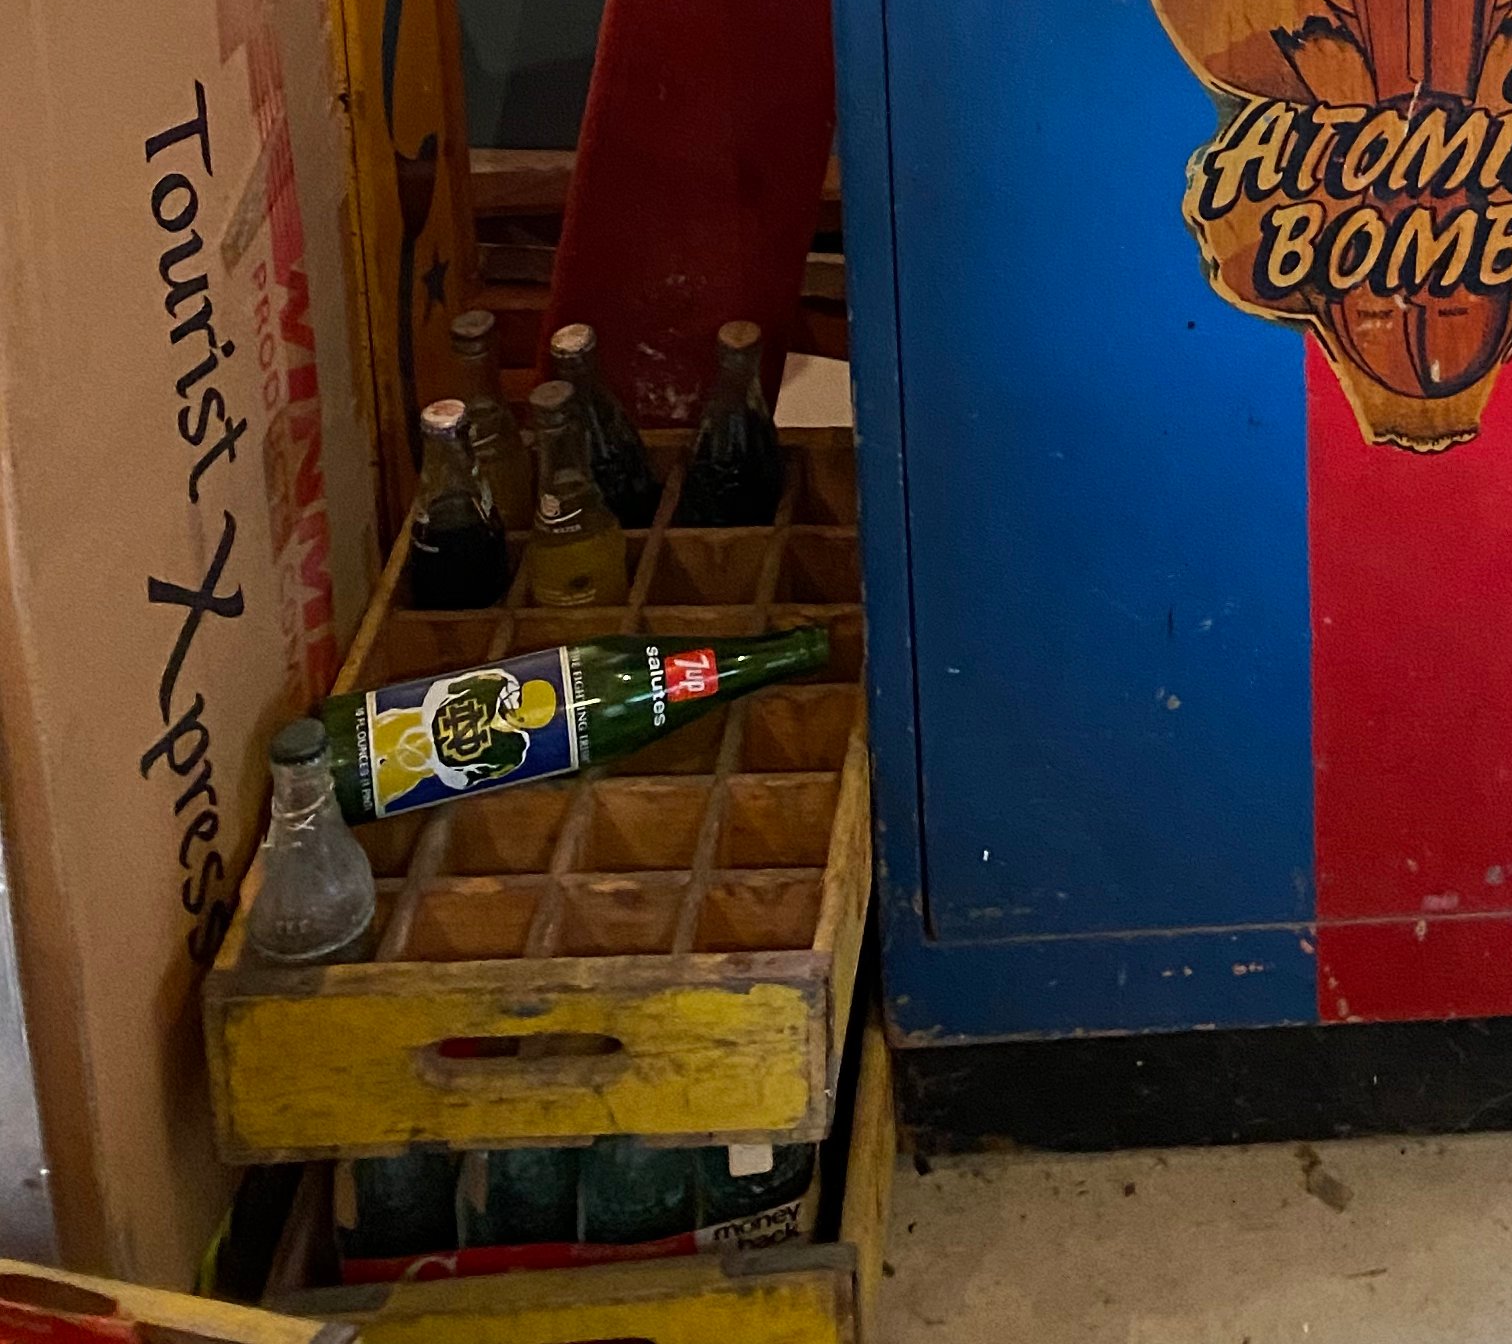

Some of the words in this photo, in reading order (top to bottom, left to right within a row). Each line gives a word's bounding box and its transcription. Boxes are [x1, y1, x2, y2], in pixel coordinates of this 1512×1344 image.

[145, 79, 247, 504] Tourist
[645, 645, 667, 728] salutes
[712, 1202, 801, 1242] money
